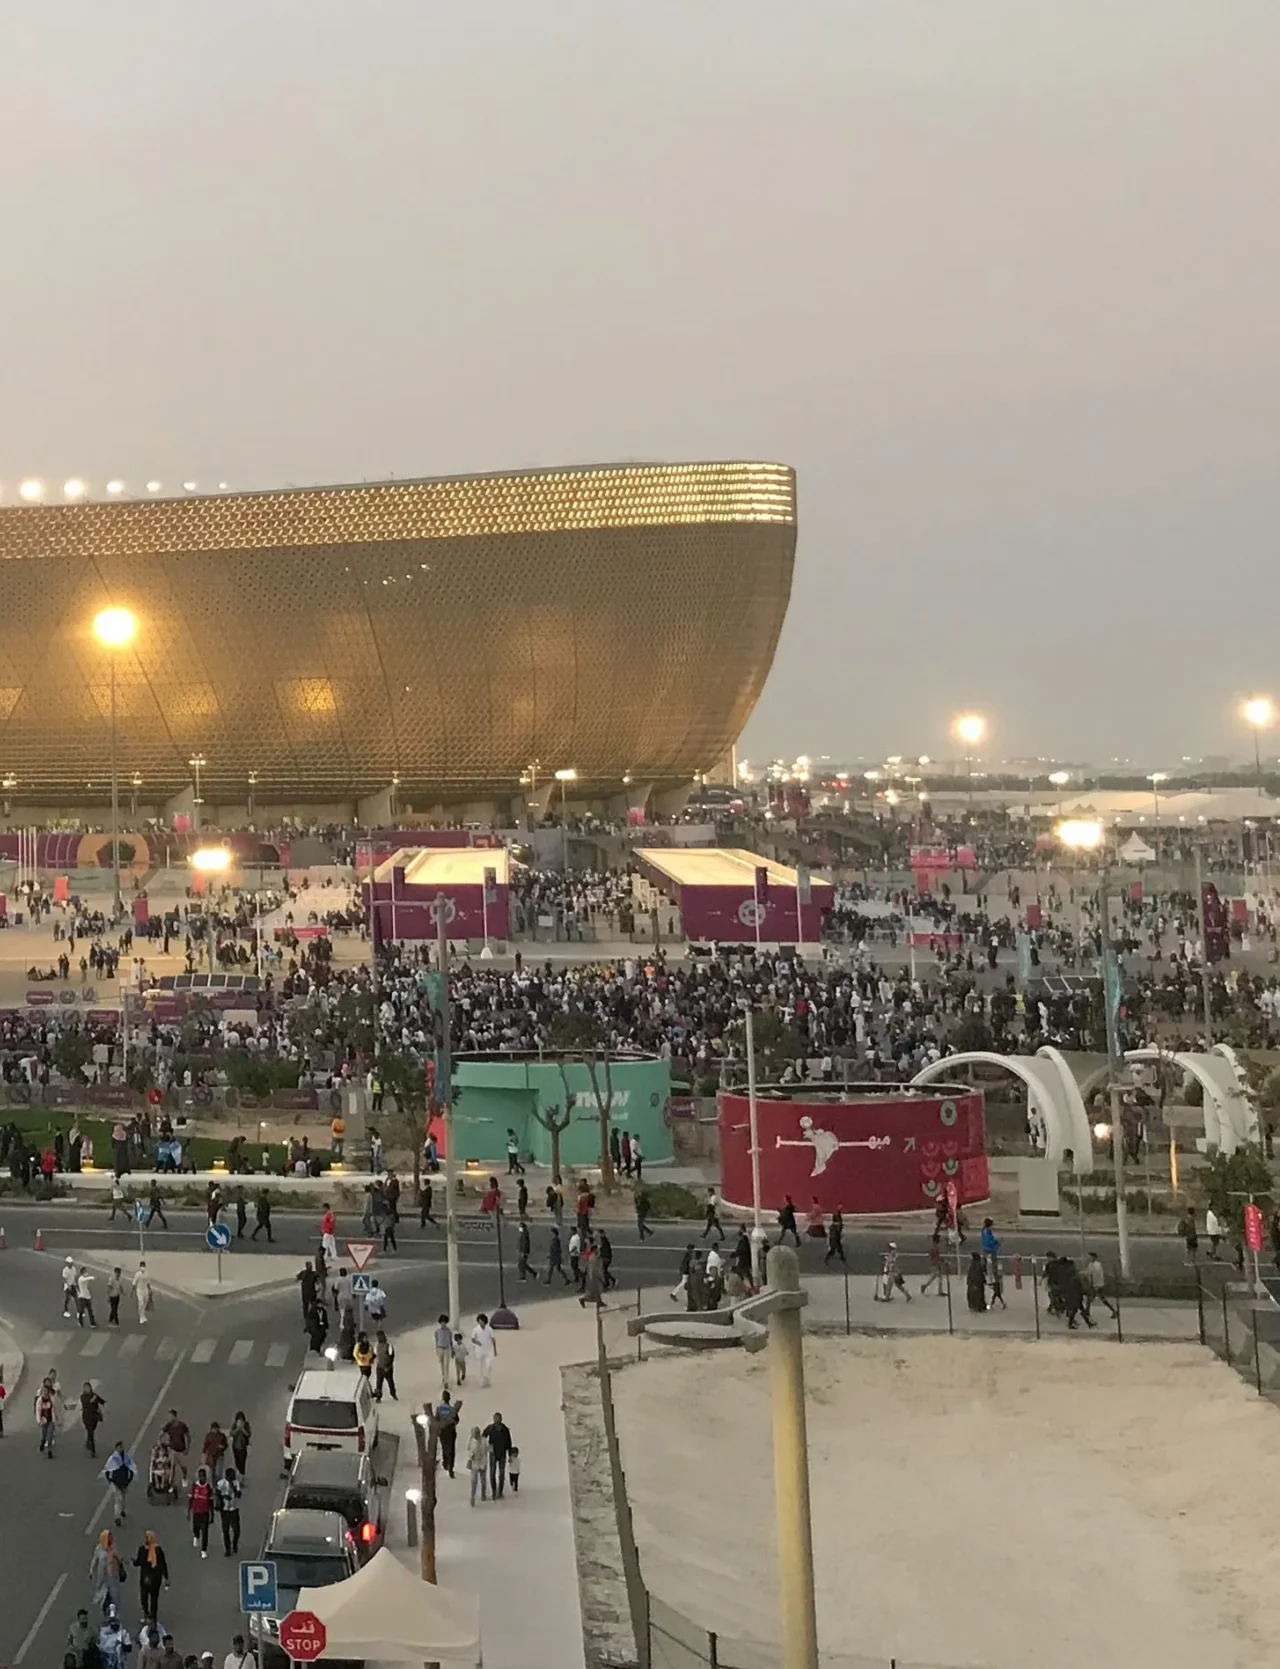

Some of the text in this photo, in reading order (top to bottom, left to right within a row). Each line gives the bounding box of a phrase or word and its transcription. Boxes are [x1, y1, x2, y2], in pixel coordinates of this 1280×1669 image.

[247, 1566, 269, 1595] P
[290, 1619, 316, 1634] قف
[286, 1638, 321, 1652] STOP
